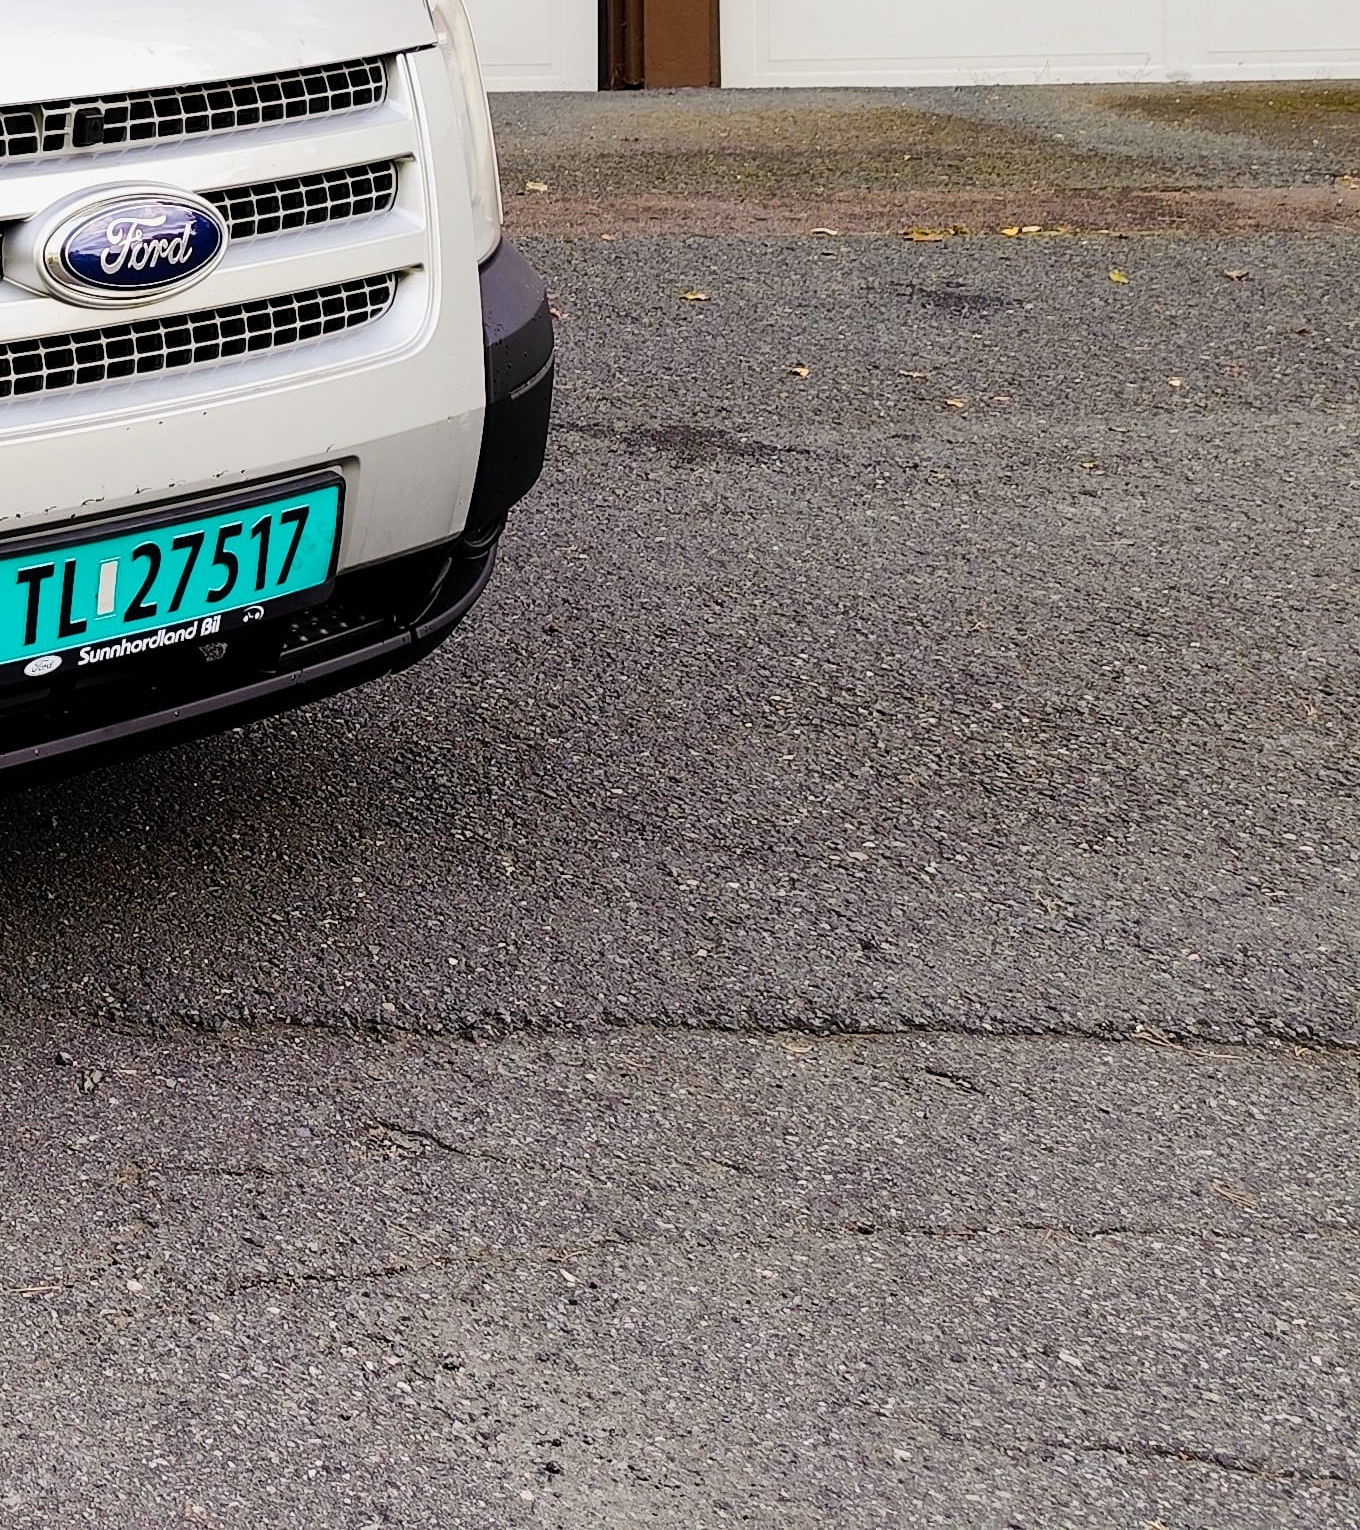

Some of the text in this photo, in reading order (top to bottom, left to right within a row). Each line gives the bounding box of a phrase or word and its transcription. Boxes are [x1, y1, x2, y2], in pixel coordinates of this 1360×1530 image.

[100, 213, 194, 275] Ford
[17, 505, 310, 646] TL 27517
[78, 622, 197, 666] Sunnhordland
[199, 614, 222, 637] Bil
